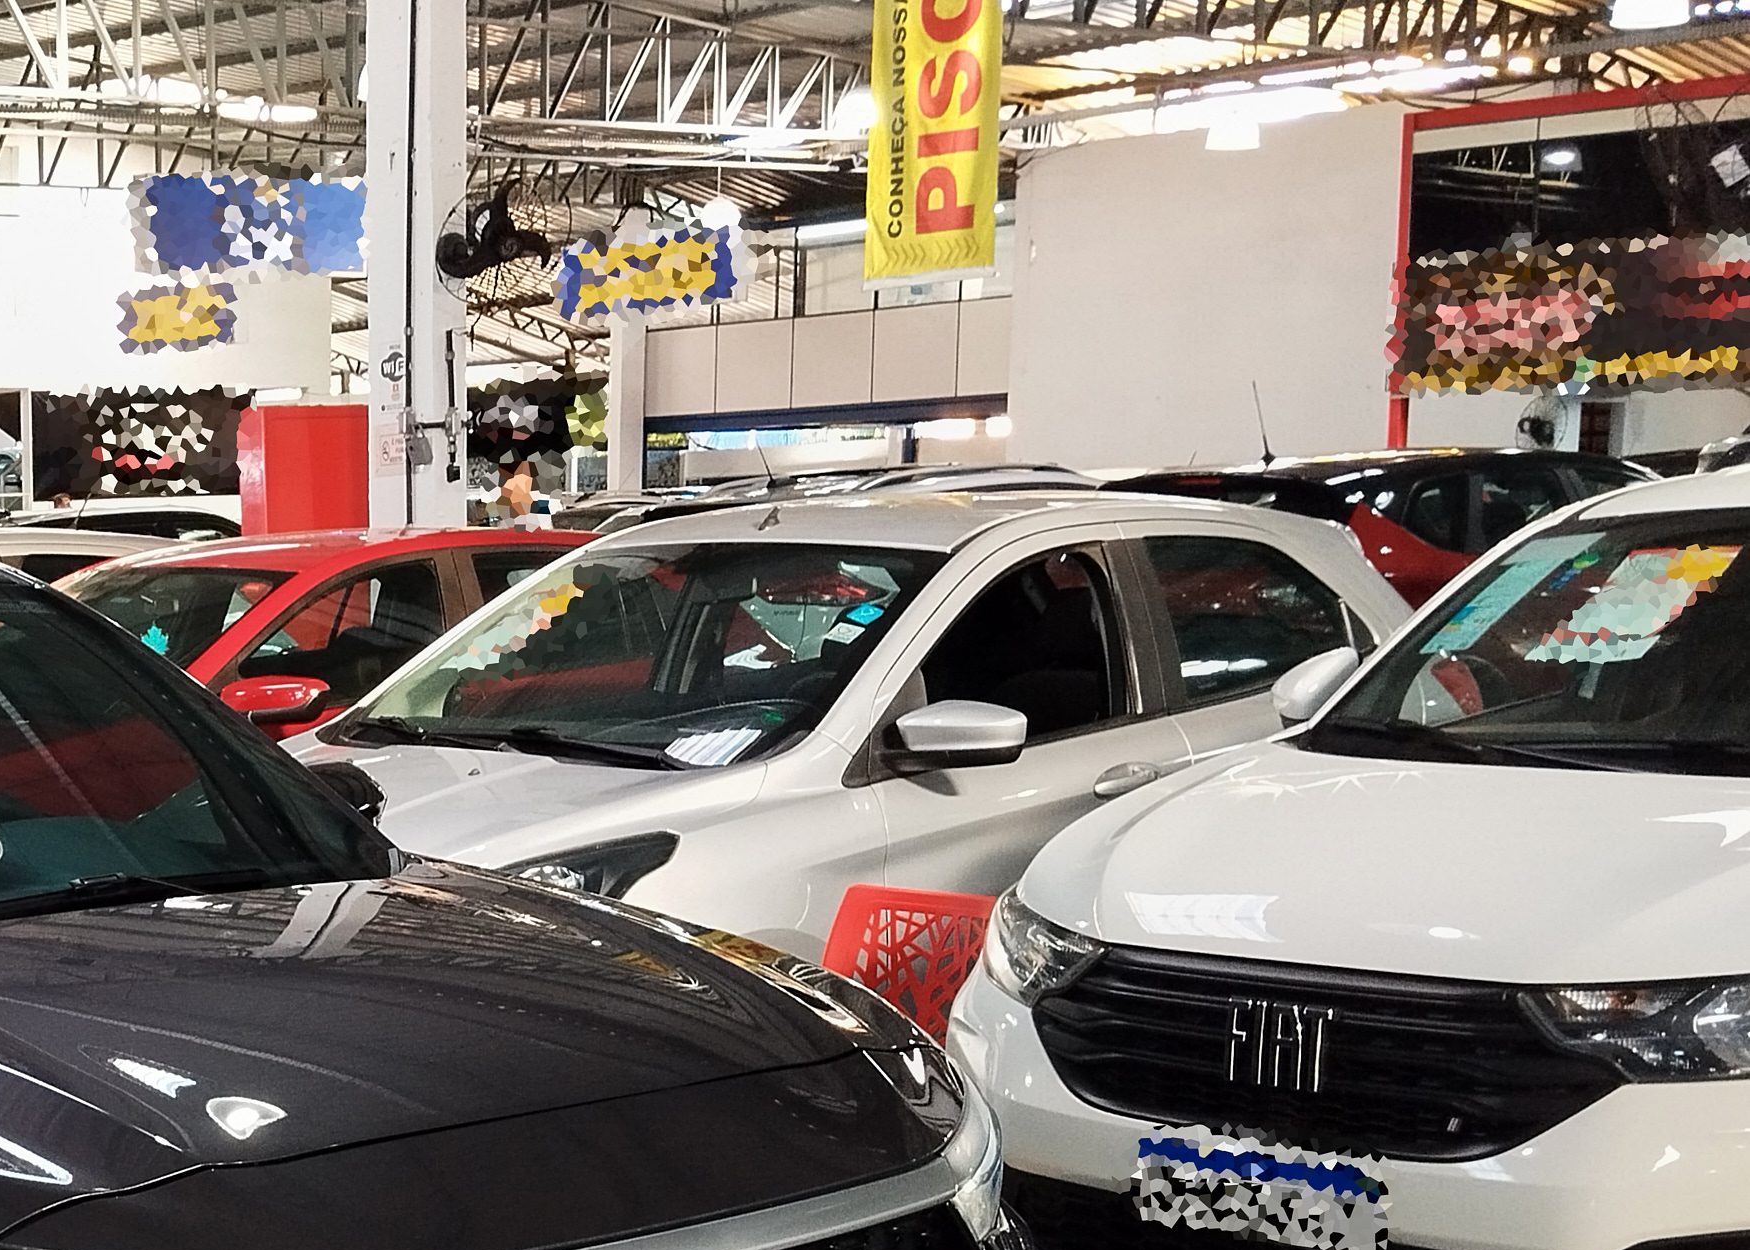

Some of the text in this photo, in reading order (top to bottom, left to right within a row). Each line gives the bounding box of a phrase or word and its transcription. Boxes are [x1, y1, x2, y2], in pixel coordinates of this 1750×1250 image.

[887, 0, 908, 238] CONHEÇA NOSS
[1225, 998, 1335, 1094] FIAT
